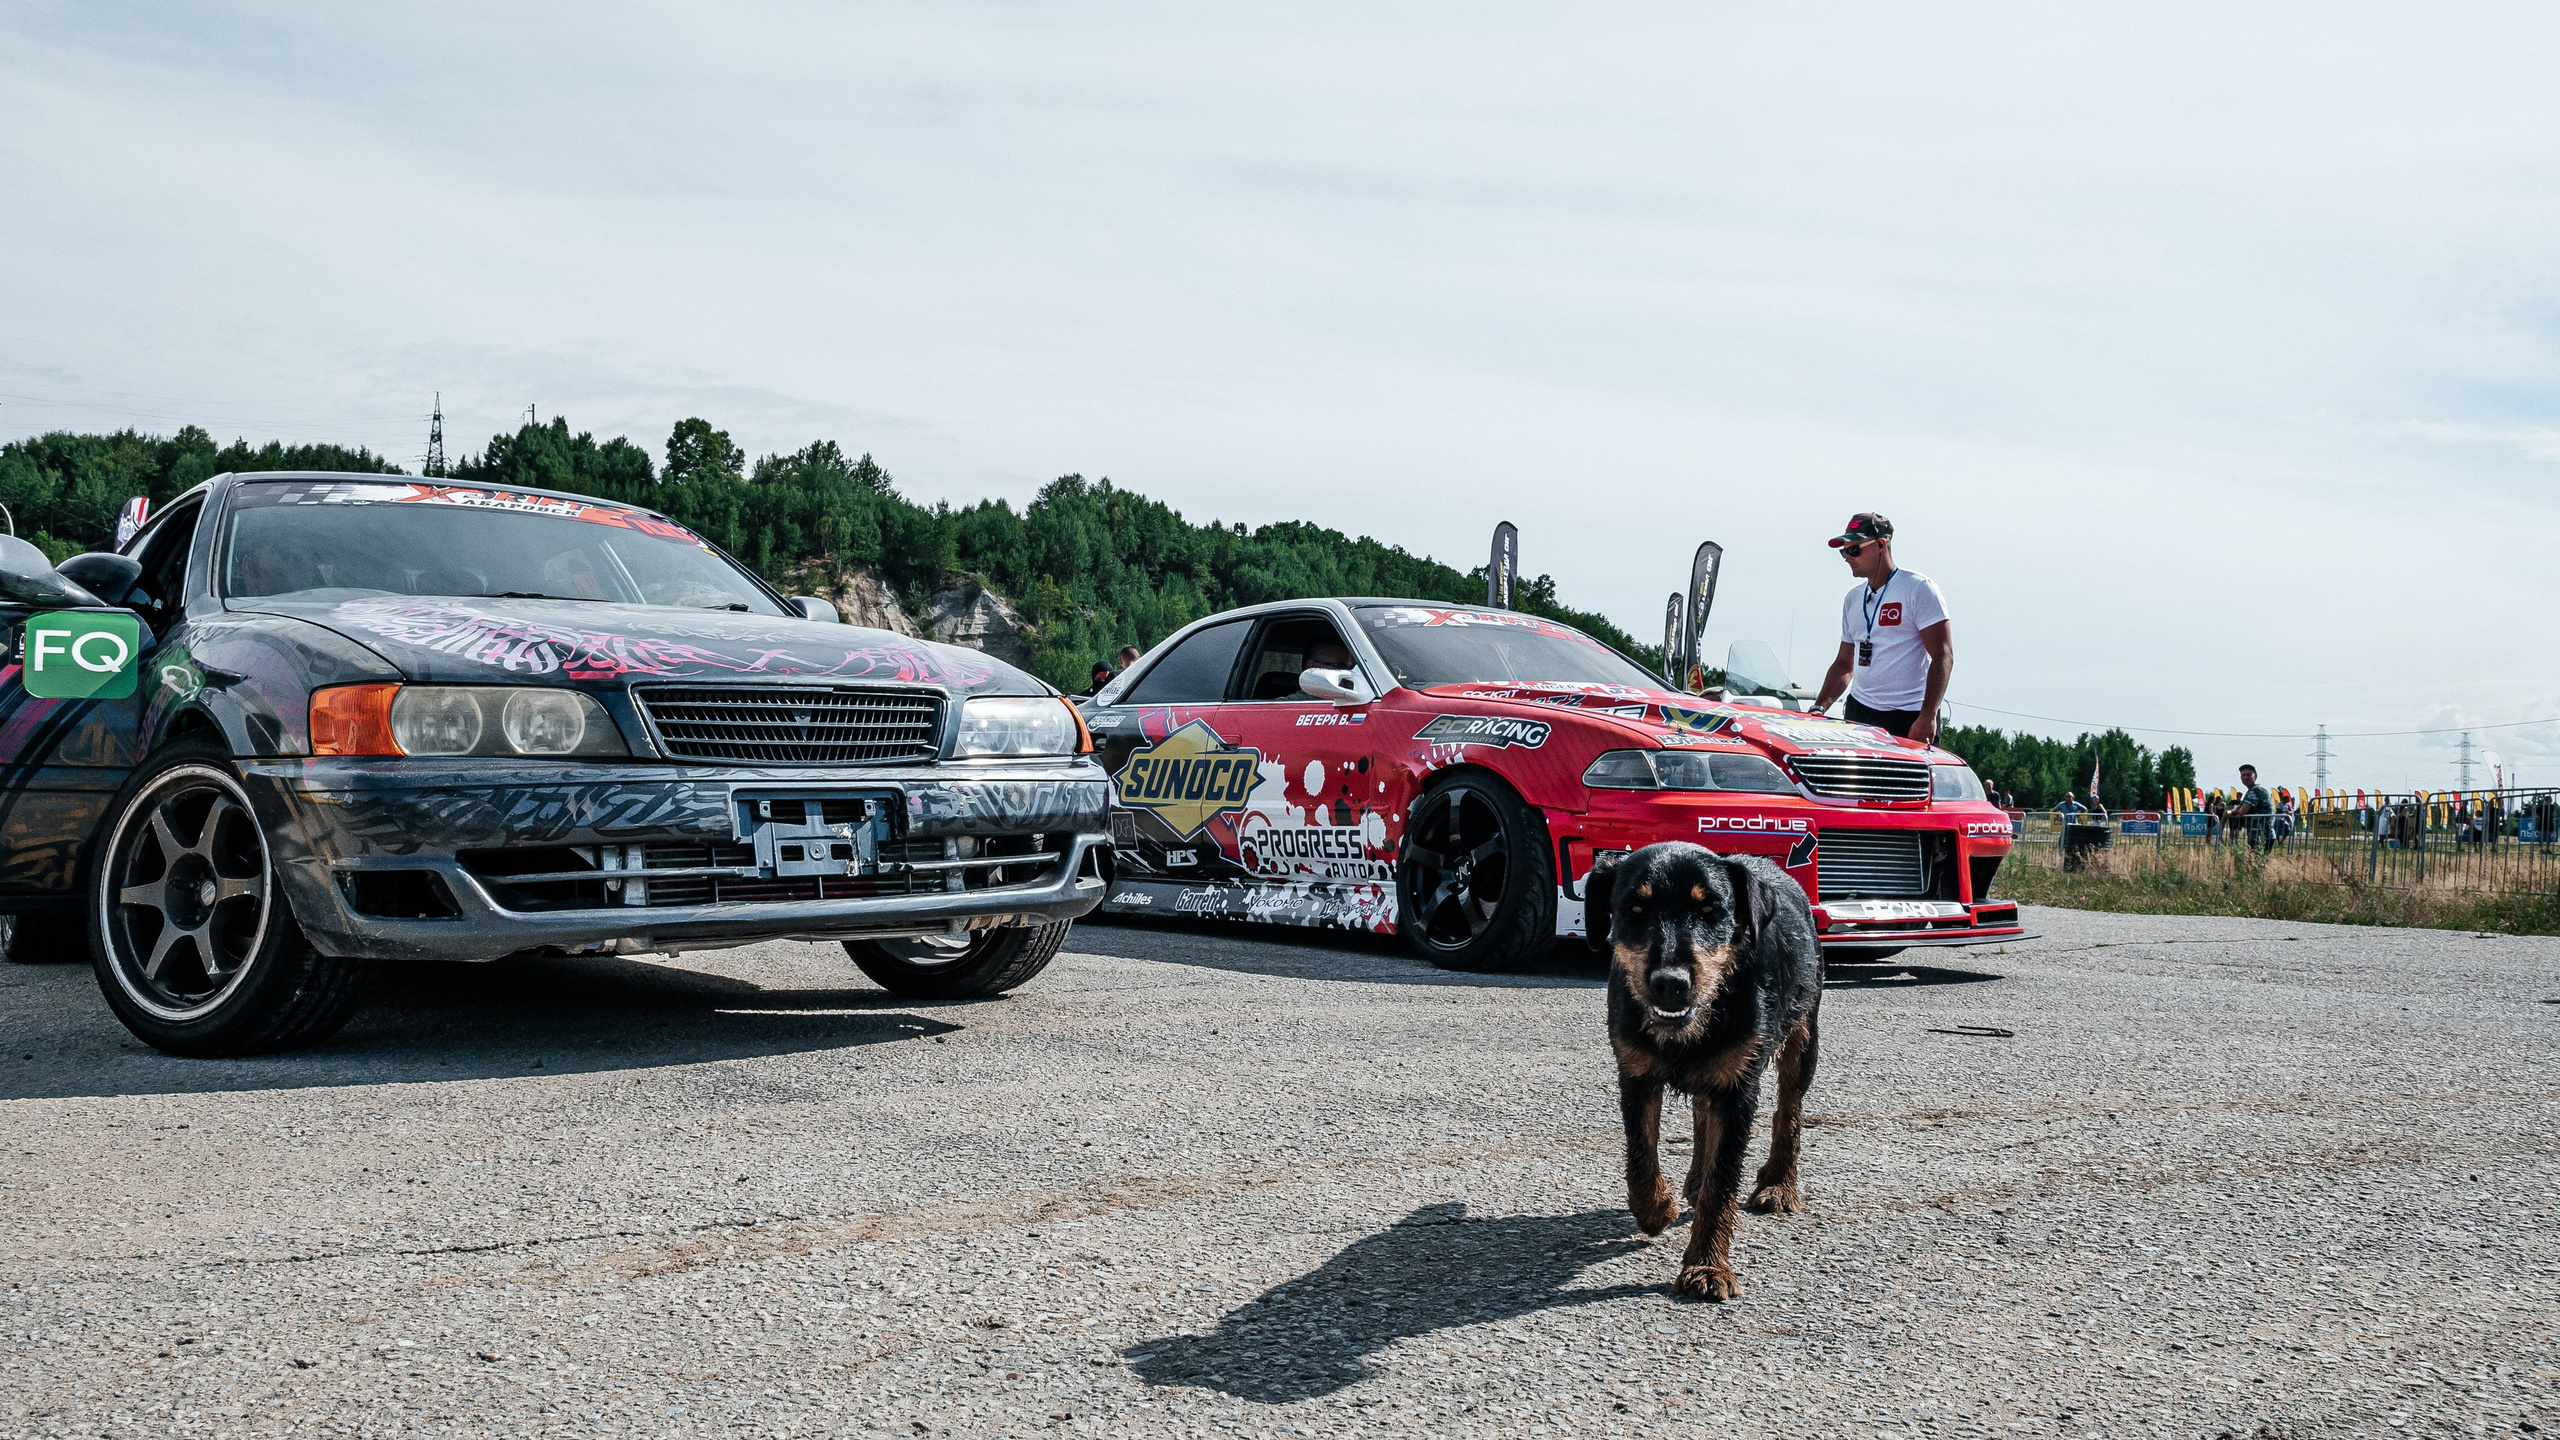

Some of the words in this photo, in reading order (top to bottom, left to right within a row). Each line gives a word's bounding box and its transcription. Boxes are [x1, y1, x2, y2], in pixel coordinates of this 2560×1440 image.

[1880, 608, 1900, 620] FQ
[34, 629, 122, 673] FQ
[1462, 689, 1519, 698] COCKPIT
[1296, 714, 1339, 726] ВЕГЕРЯ
[1465, 720, 1545, 744] RACING
[1124, 758, 1253, 802] SUNOCO
[1697, 813, 1808, 833] prodrive
[1256, 829, 1362, 859] PROGRESS
[1166, 849, 1198, 867] HPS
[1112, 892, 1153, 905] Achilles
[1176, 888, 1220, 911] Garrett
